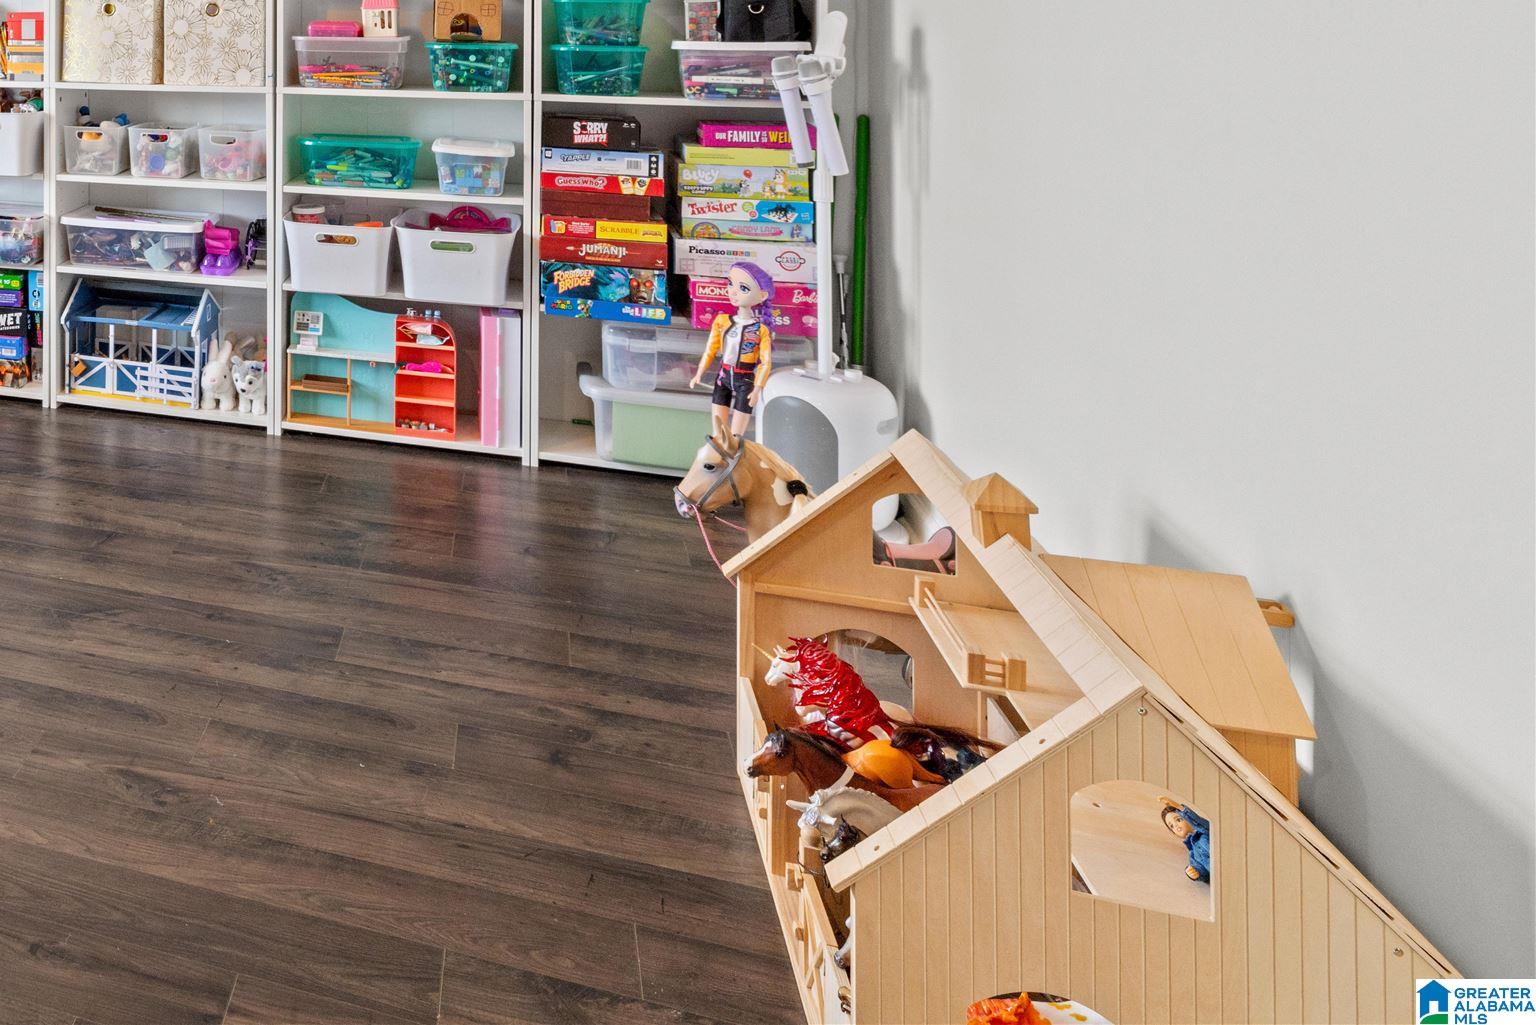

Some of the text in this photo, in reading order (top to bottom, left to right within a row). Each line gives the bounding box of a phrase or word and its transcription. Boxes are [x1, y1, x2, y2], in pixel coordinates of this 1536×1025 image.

[727, 131, 761, 142] FAMILY
[769, 131, 792, 144] WEI
[688, 202, 737, 215] Twister
[578, 243, 626, 258] JUMANJI
[688, 246, 725, 255] Picasso
[553, 268, 595, 285] FORBIDDEN
[558, 277, 591, 294] BRIDGE
[697, 284, 729, 296] MONO
[792, 289, 818, 304] Barbi
